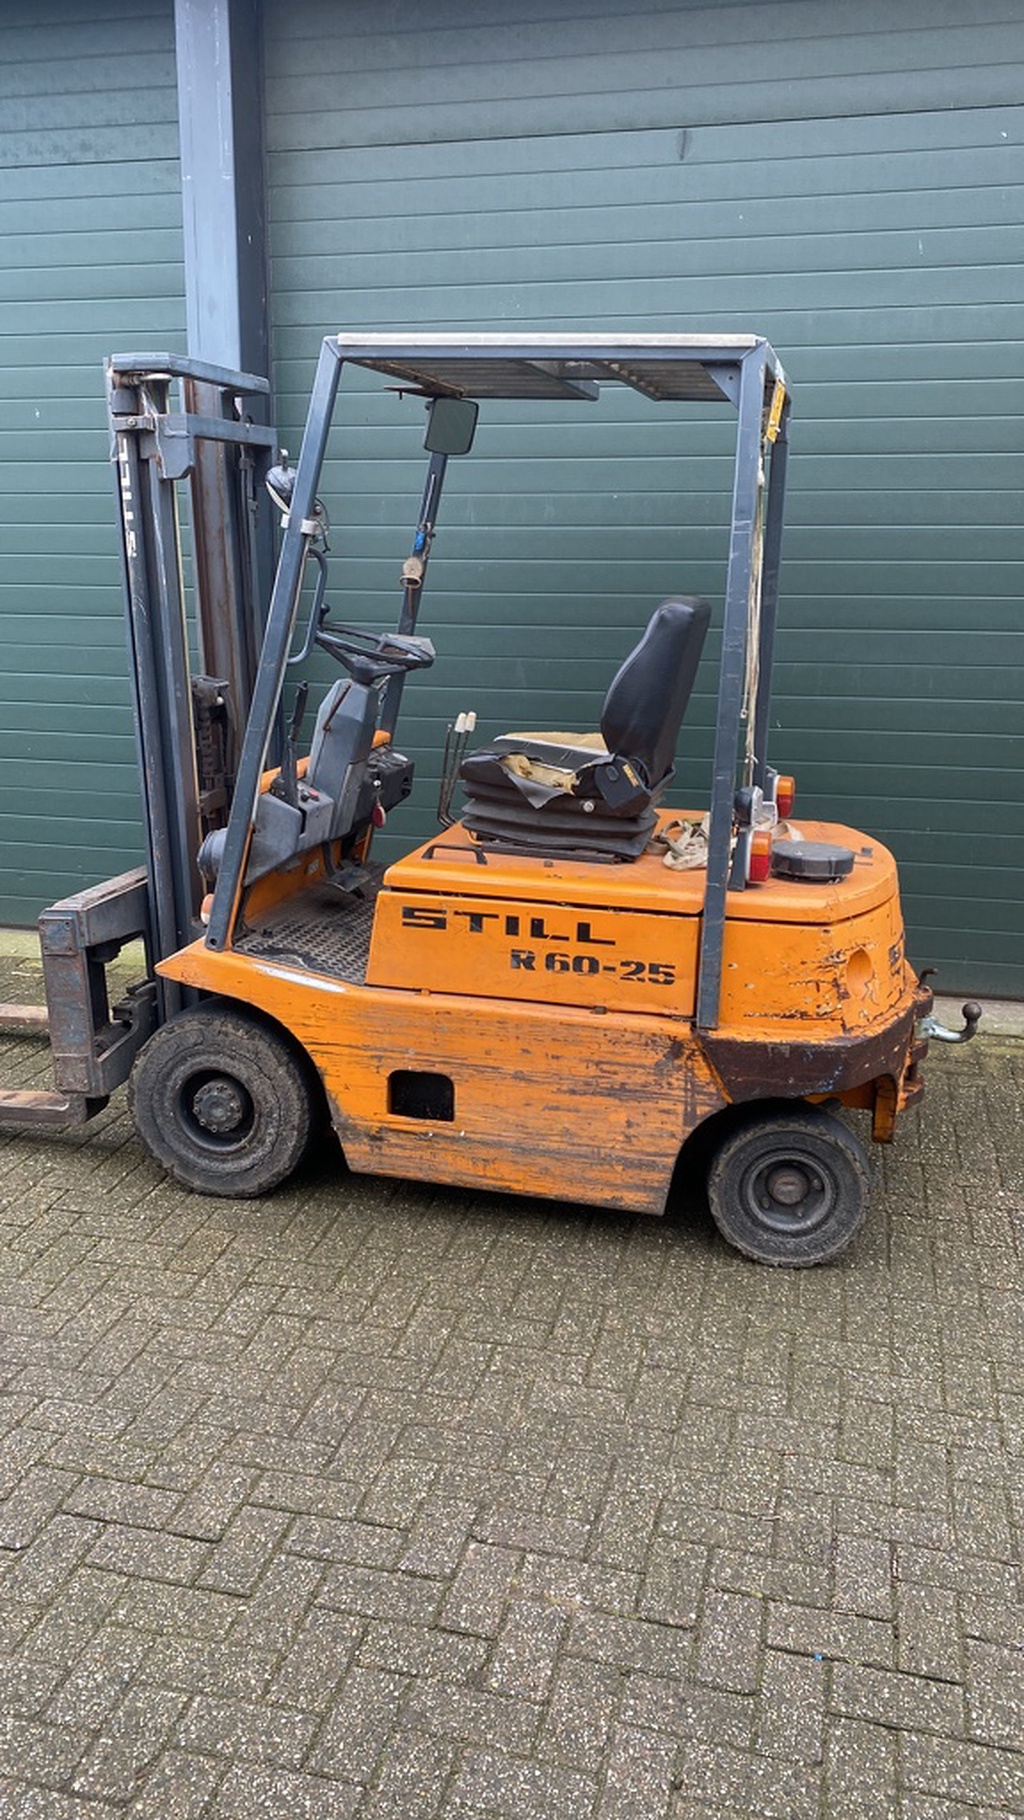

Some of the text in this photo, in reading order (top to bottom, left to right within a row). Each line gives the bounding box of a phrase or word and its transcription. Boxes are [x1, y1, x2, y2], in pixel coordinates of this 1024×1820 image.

[402, 906, 616, 946] STILL
[511, 949, 676, 986] R 60-25
